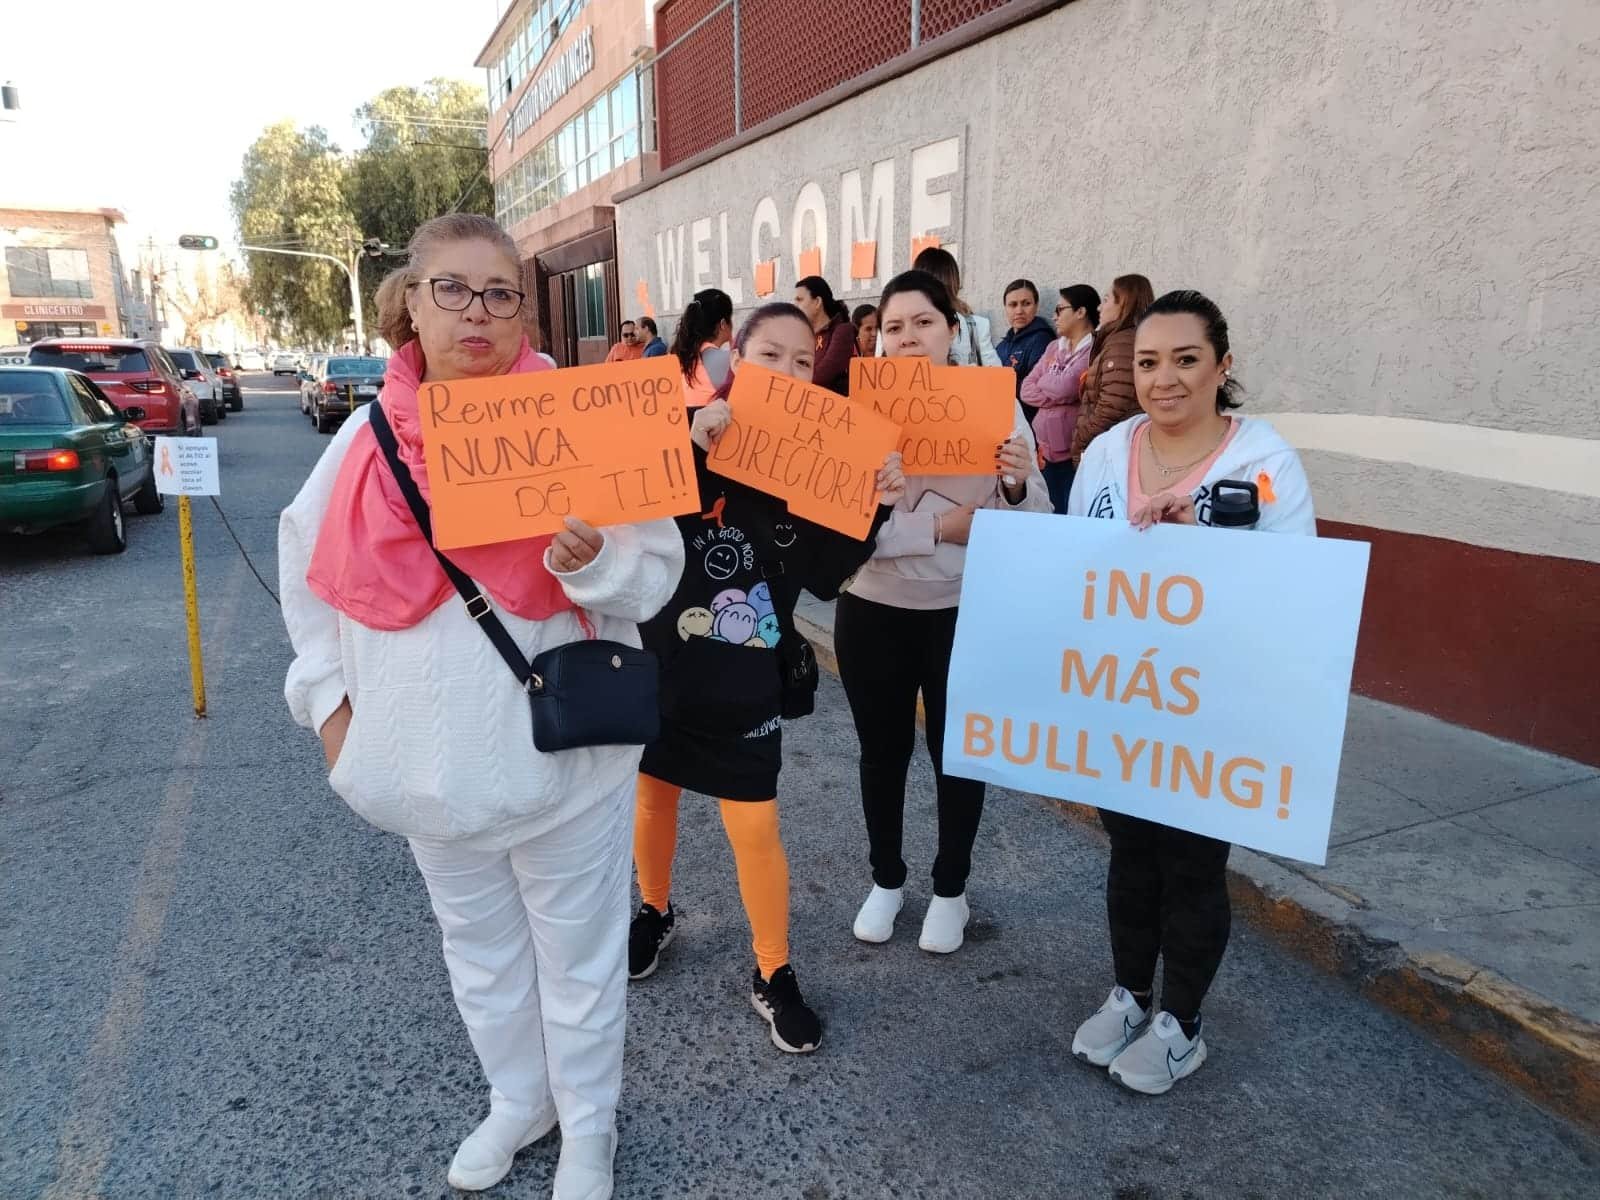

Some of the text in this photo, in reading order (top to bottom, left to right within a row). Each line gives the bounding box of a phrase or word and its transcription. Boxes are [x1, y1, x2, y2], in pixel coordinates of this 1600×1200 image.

[656, 137, 959, 311] WELCOME
[24, 304, 84, 317] CLINICENTRO
[766, 375, 857, 434] FUERA
[858, 360, 944, 392] NO AL
[441, 427, 579, 482] NUNCA
[792, 422, 825, 450] LA
[713, 419, 880, 519] DIRECTORA!
[692, 535, 706, 550] IN
[719, 526, 744, 541] GOOD
[1082, 569, 1204, 626] ¡NO
[1060, 647, 1201, 716] MÁS
[963, 712, 1294, 820] BULLYING!
